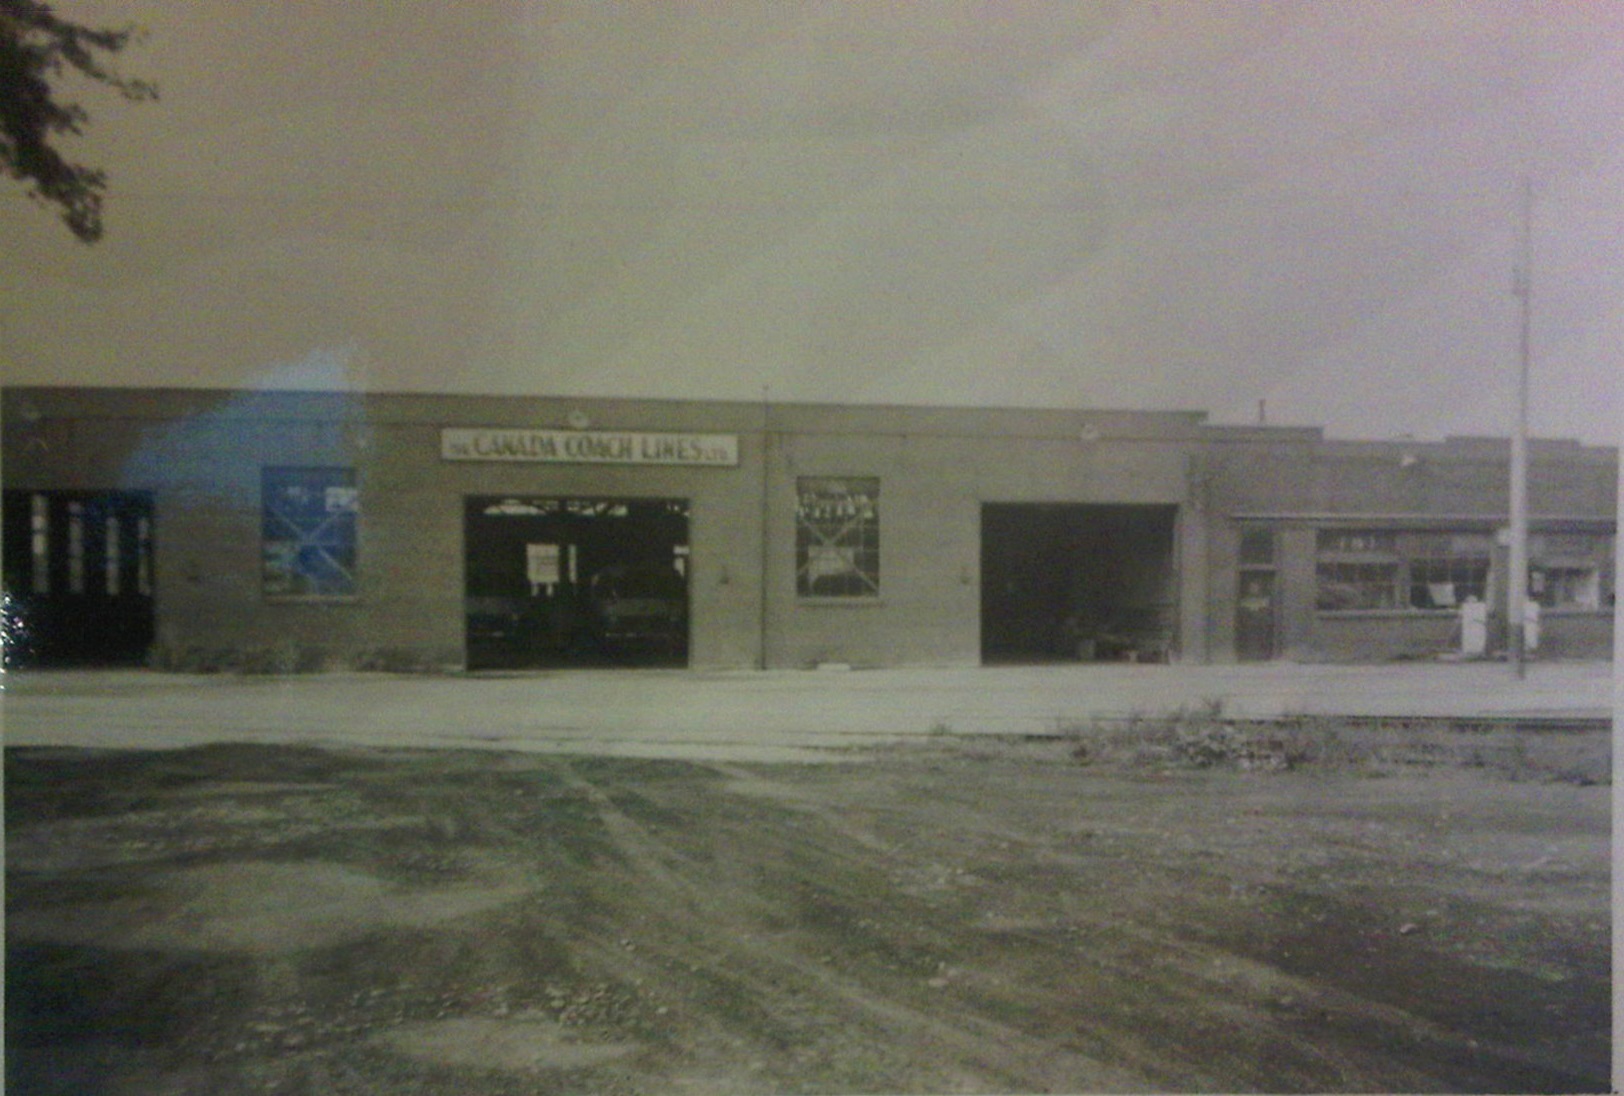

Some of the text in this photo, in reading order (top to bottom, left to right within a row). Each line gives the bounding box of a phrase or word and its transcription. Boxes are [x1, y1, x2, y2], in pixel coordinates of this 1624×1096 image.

[473, 434, 556, 456] CANADA
[565, 436, 632, 459] COACH
[641, 437, 701, 461] LINES
